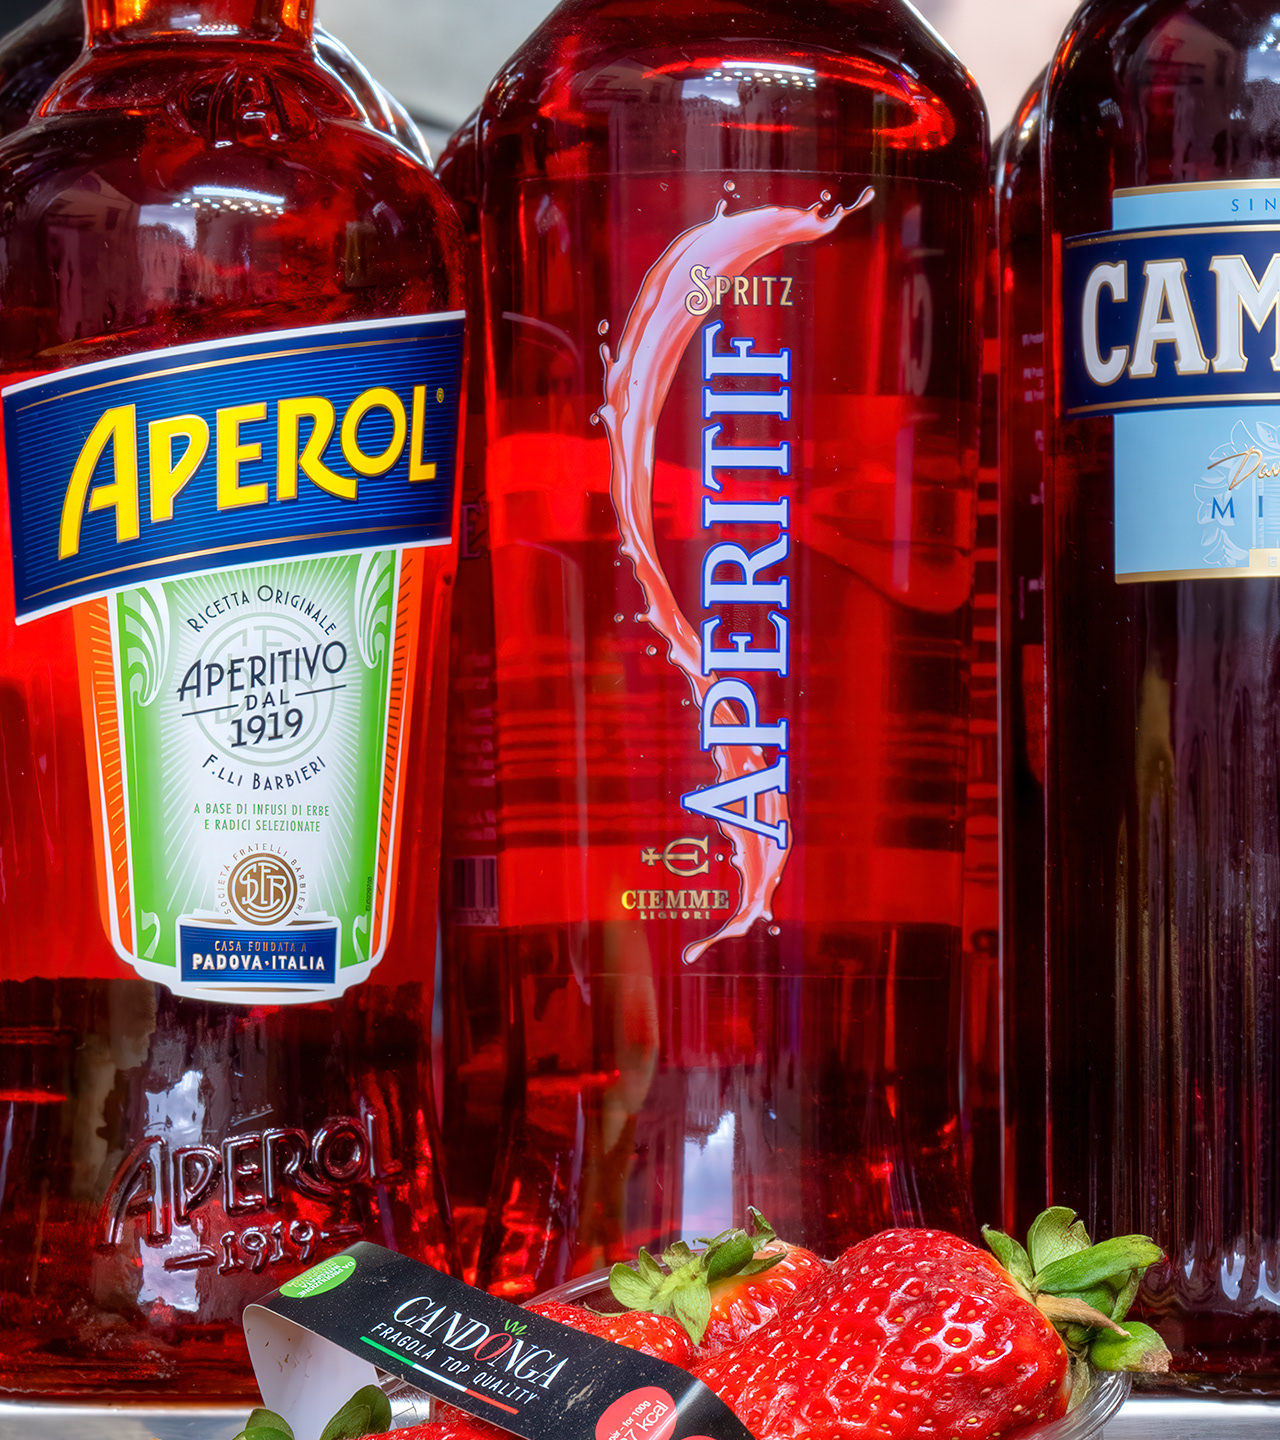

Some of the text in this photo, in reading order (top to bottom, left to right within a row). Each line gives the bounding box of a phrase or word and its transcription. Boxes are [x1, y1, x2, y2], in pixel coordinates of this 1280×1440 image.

[683, 262, 796, 318] SPRITZ
[57, 383, 438, 562] APEROL
[187, 584, 337, 636] RICETTA ORIGINALE
[680, 318, 793, 851] APERITIF
[176, 640, 348, 703] APERITIVO
[244, 689, 290, 711] DAL
[230, 707, 304, 748] 1919
[202, 753, 327, 791] F.LLI BARBIERI
[193, 803, 330, 817] A BASE DI INFUSI DI ERBE
[204, 819, 321, 832] E RADICI SELEZIONATE
[232, 843, 307, 917] FRATELLI BARBIERI
[621, 890, 729, 910] CIEMME
[214, 940, 296, 952] CASA FONDATA
[95, 1112, 406, 1253] APEROL
[218, 1219, 318, 1275] 1919
[368, 1320, 541, 1408] FRAGOLA TOP QUALITY
[392, 1295, 570, 1392] CANDONGA
[636, 1400, 669, 1431] kcal
